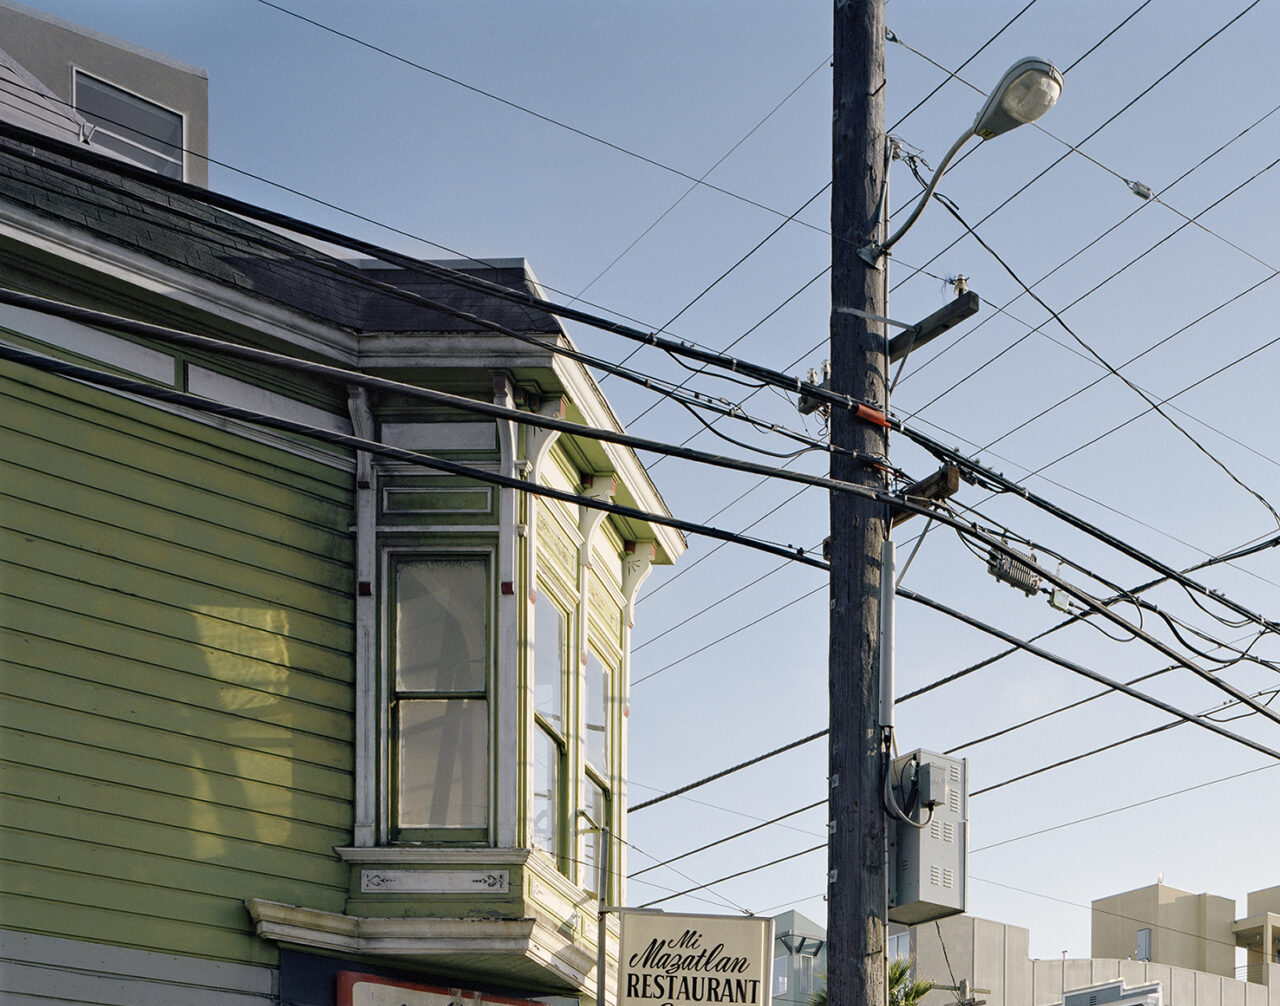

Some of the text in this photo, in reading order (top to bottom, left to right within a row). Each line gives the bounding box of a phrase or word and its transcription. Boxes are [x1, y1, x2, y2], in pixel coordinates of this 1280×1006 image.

[668, 929, 703, 949] Mi
[629, 938, 750, 974] Mazatlan
[627, 973, 760, 1004] RESTAURANT
